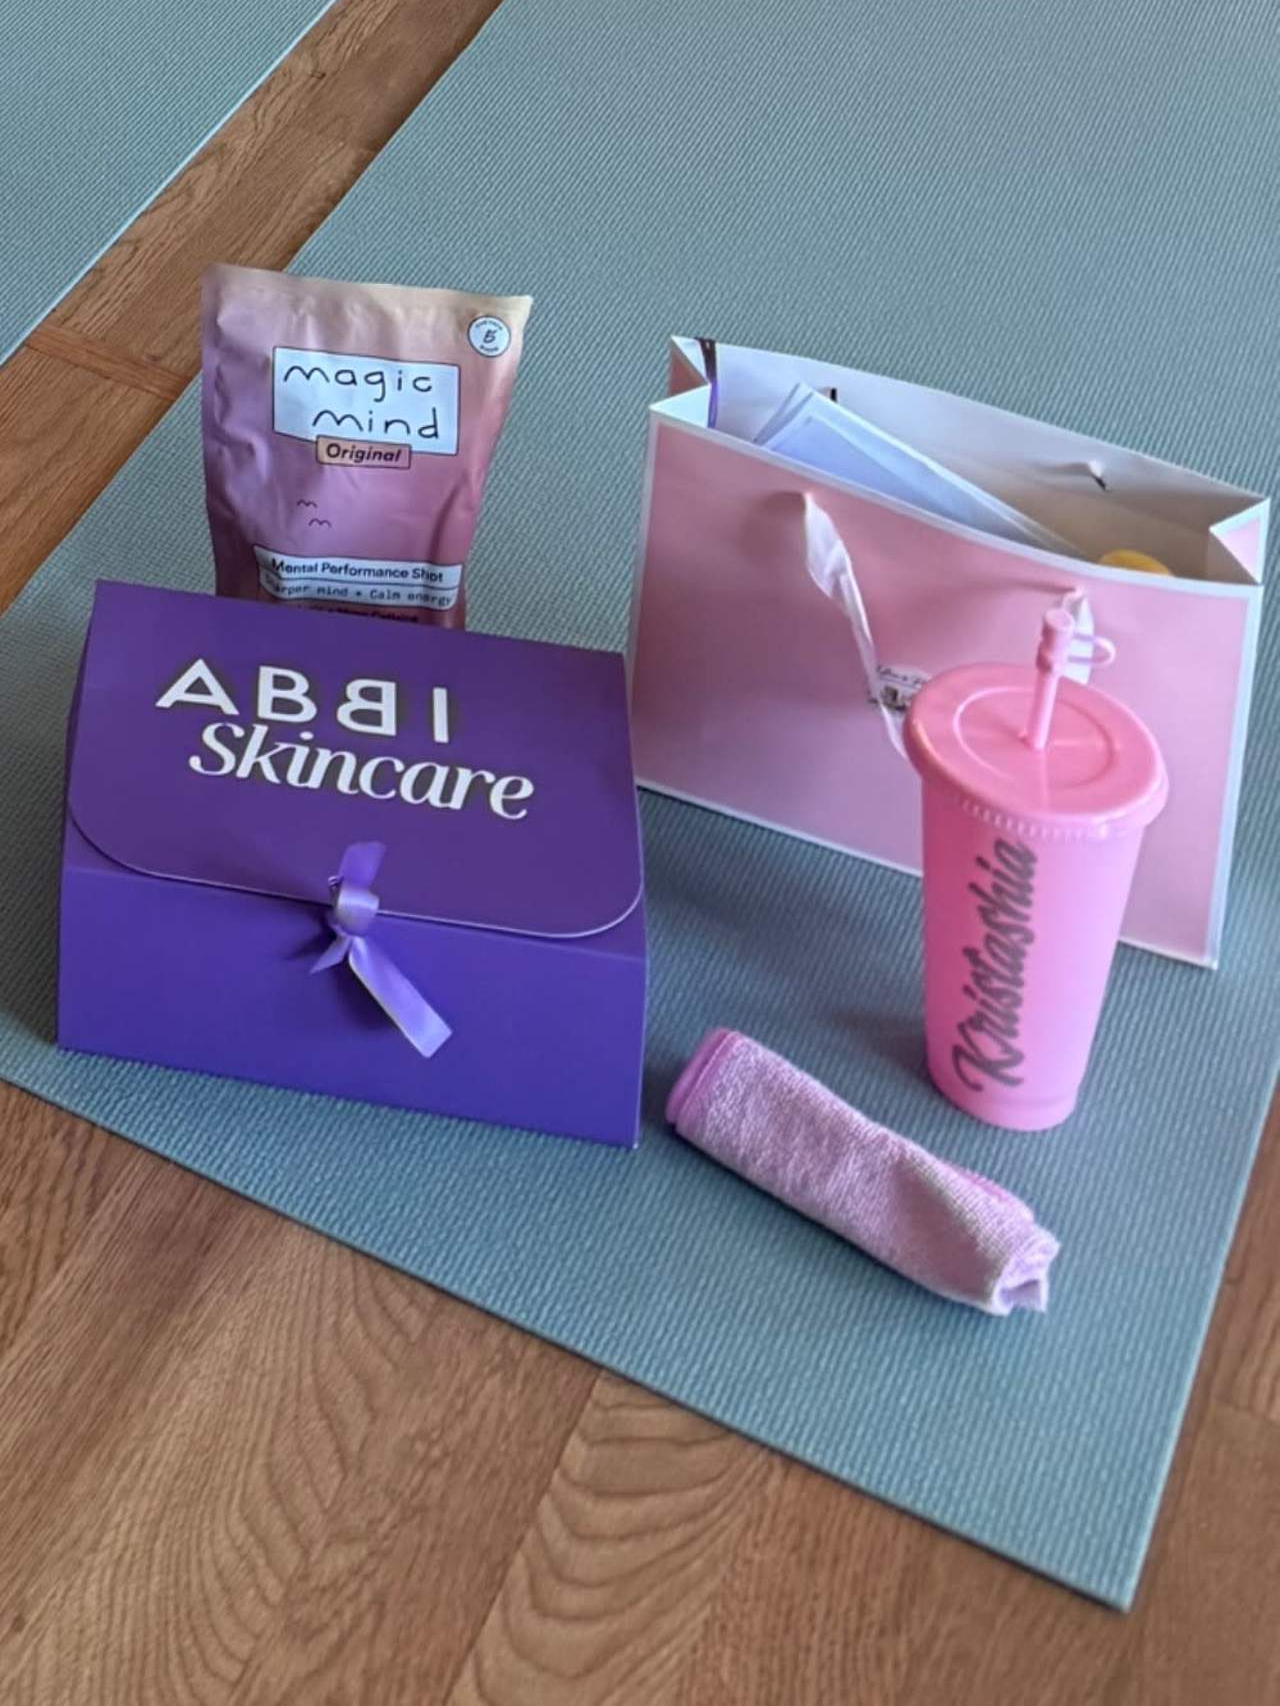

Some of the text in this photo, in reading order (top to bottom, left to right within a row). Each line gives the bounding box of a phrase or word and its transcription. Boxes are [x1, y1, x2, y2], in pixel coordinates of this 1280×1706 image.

[283, 365, 433, 403] magic
[312, 407, 440, 439] mind
[326, 443, 401, 463] Original
[272, 558, 443, 583] Mental Performance Shot
[317, 586, 349, 598] mind
[370, 589, 401, 601] Calm
[407, 591, 452, 607] energy
[154, 658, 450, 743] ABBI
[188, 722, 534, 820] Skincare
[952, 837, 1037, 1092] Kristashia
